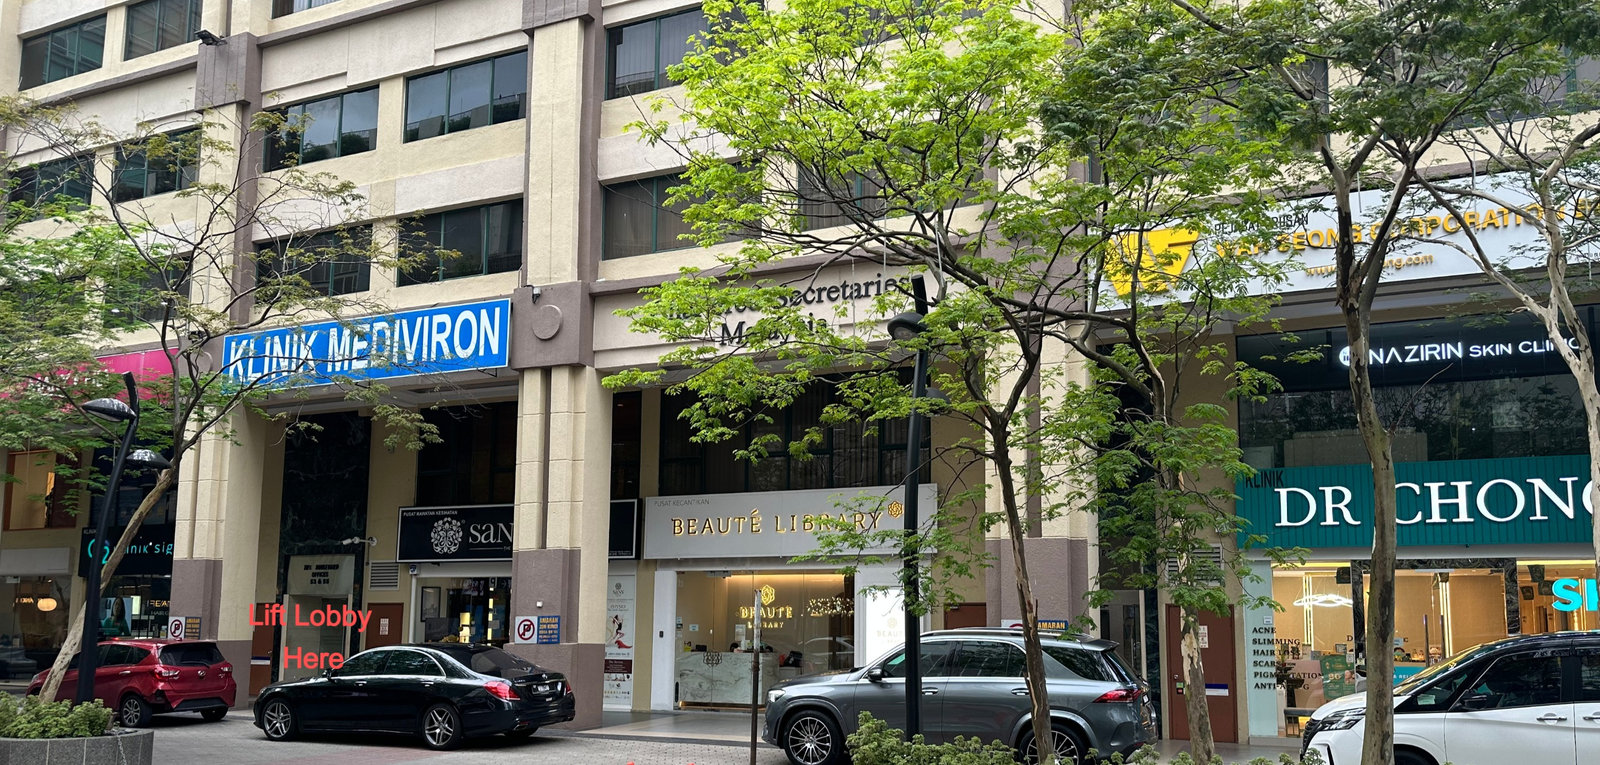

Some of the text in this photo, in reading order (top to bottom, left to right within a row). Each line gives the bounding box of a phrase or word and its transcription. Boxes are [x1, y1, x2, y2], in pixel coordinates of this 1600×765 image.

[228, 306, 501, 383] KLINIK MEDIVIRON
[1469, 342, 1512, 358] SKIN
[1245, 470, 1284, 488] KLINIK
[1274, 485, 1361, 527] DR
[671, 508, 884, 536] BEAUTÉ LIBRARY
[1252, 626, 1277, 634] ACNE
[1252, 638, 1300, 646] SLIMMING
